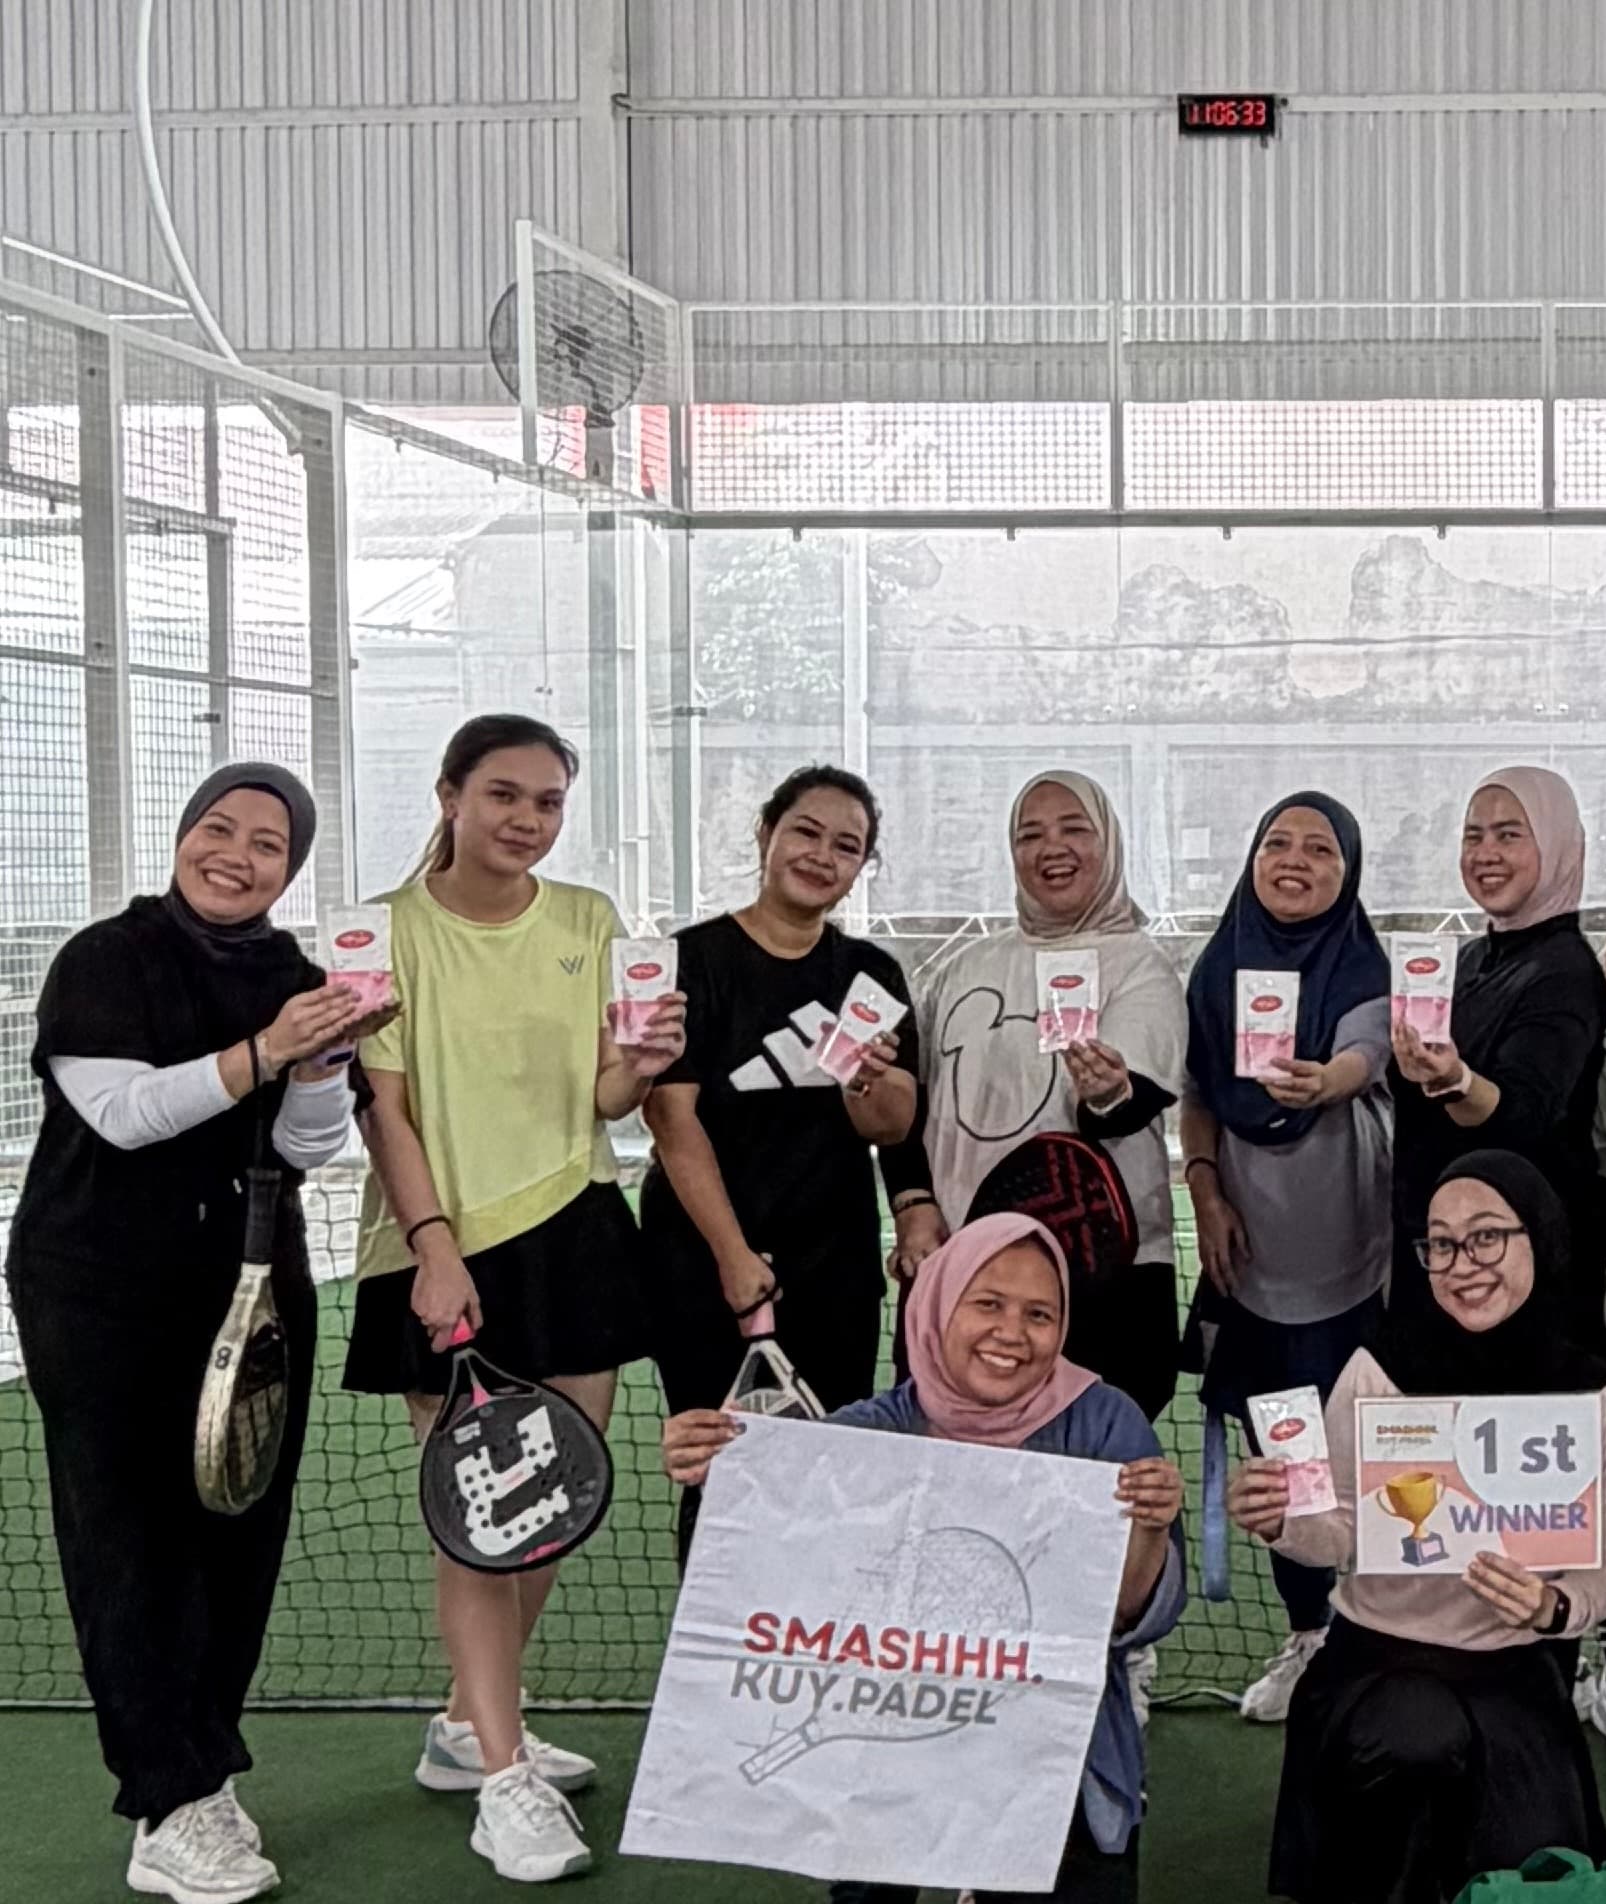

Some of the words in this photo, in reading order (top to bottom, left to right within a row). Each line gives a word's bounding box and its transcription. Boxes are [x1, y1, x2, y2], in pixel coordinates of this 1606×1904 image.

[1450, 1502, 1589, 1534] WINNER
[743, 1611, 1045, 1685] SMASHHH.
[730, 1658, 1000, 1725] KUY.PADEL
